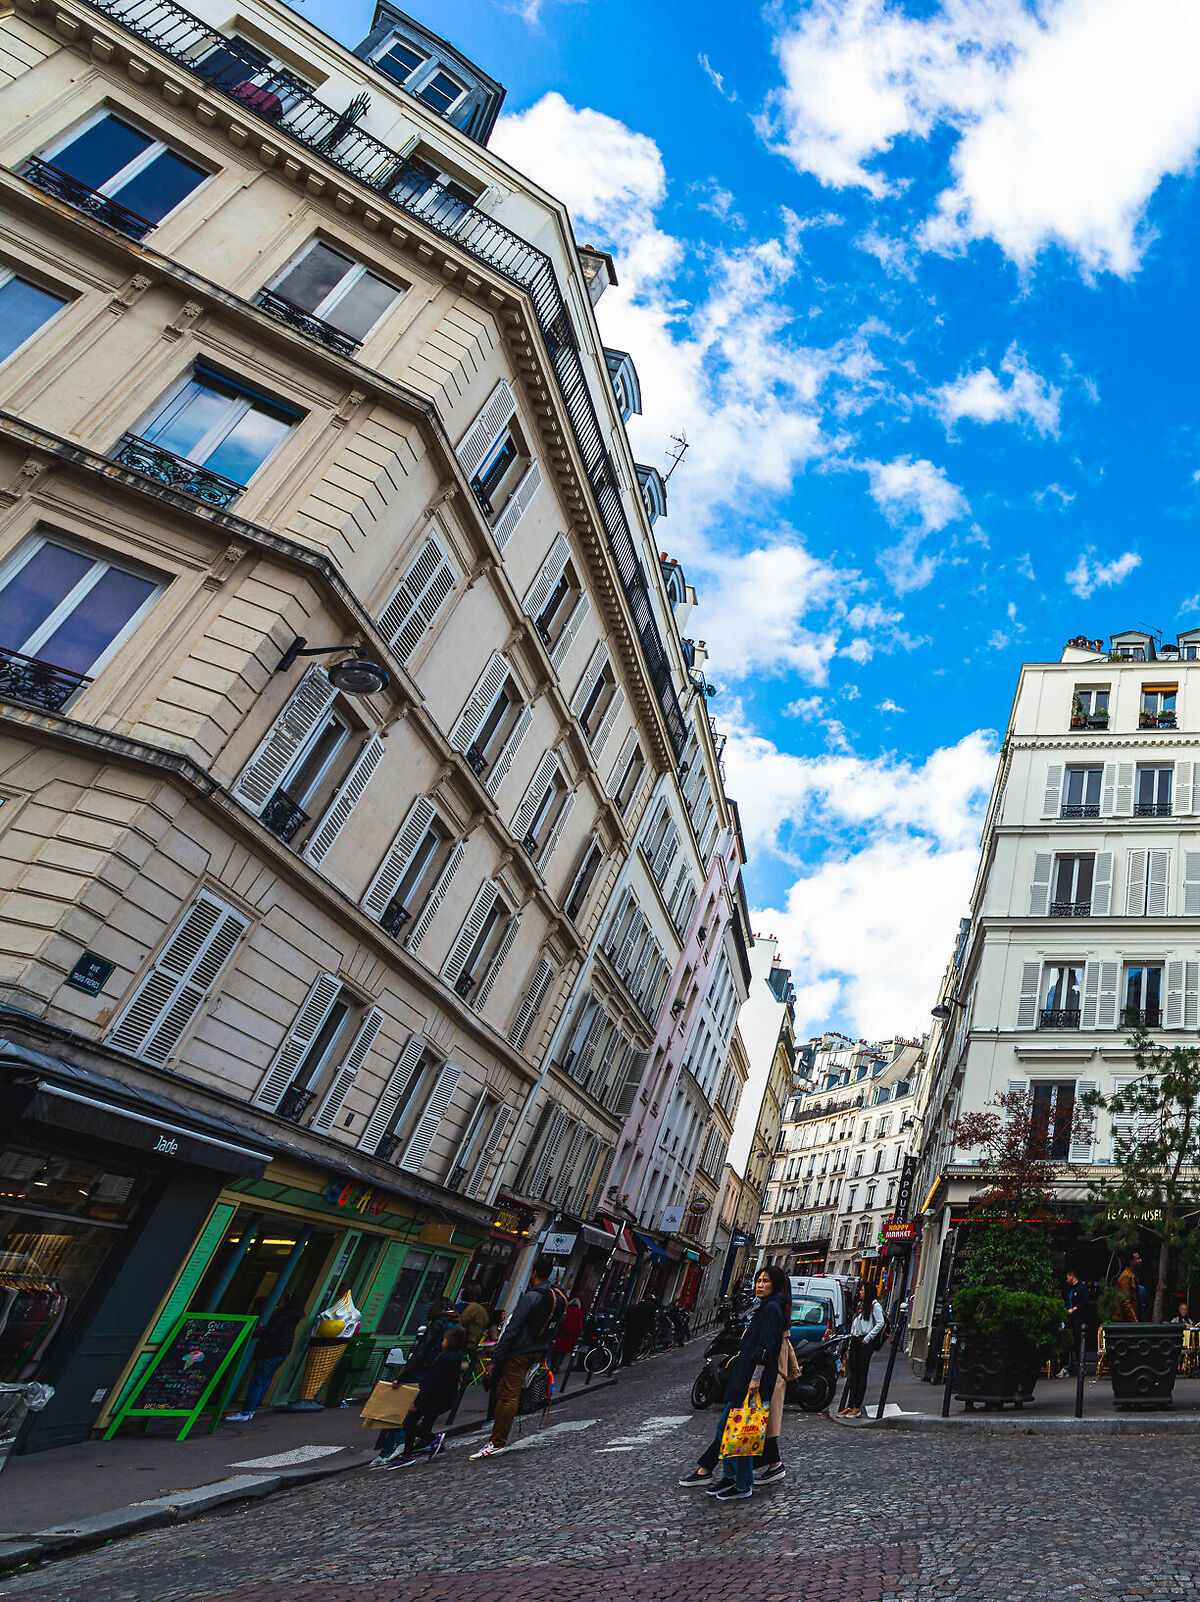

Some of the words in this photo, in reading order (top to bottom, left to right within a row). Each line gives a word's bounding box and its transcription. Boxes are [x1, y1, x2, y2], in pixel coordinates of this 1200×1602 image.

[90, 964, 100, 972] RUE
[153, 1135, 178, 1154] Jade
[905, 1159, 913, 1175] LA
[325, 1181, 391, 1216] GELATO
